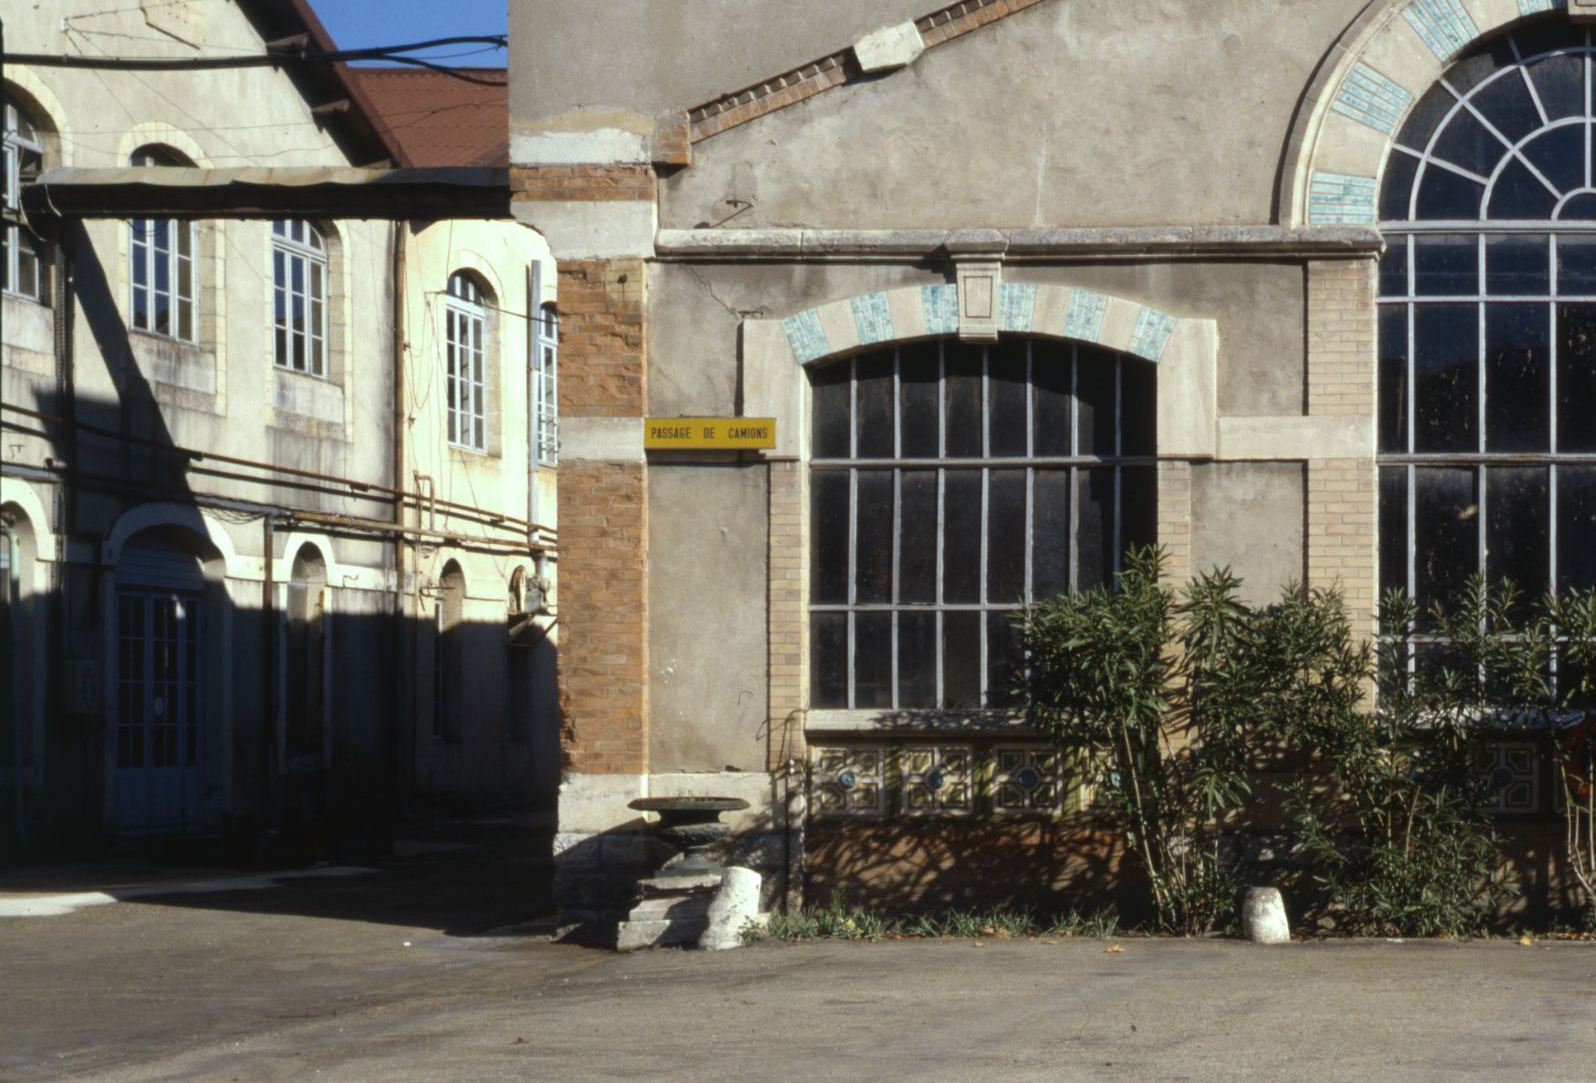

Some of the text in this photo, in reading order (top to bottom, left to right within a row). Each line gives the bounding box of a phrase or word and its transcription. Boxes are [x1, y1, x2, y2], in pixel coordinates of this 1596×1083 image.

[651, 427, 768, 439] PASSAGE DE CAMIONS
